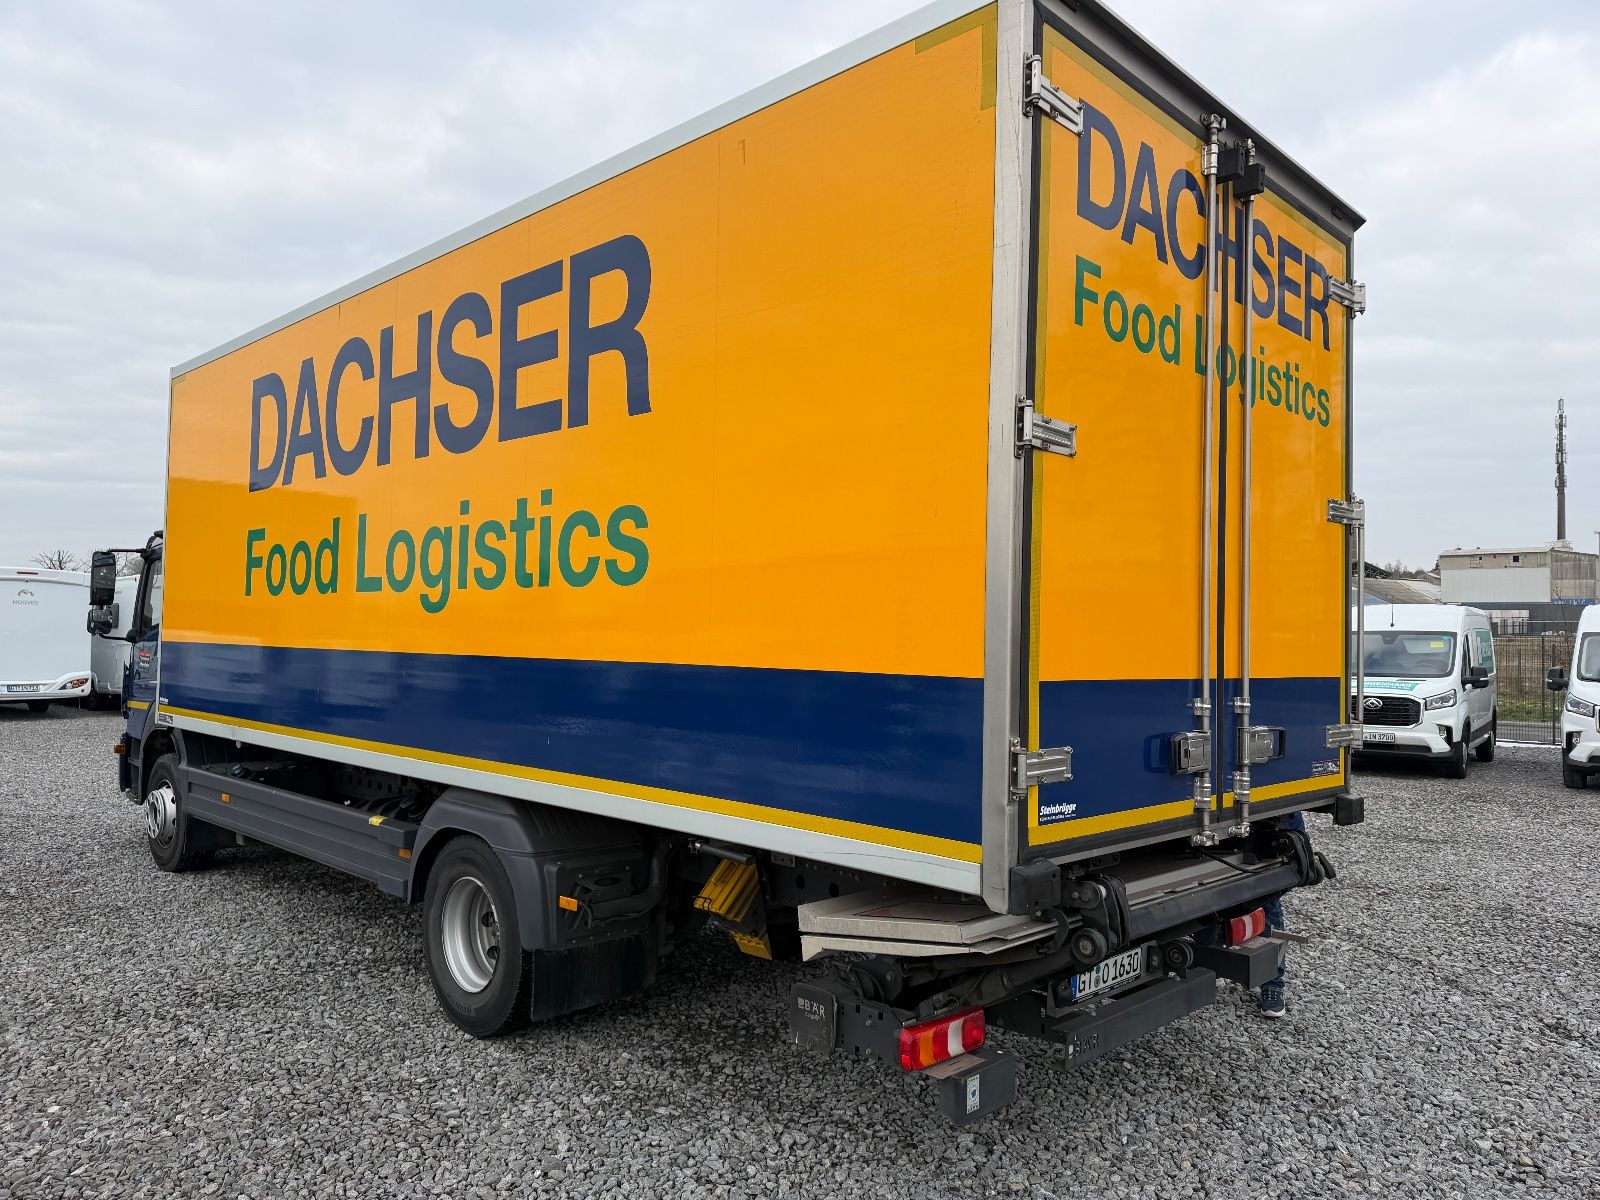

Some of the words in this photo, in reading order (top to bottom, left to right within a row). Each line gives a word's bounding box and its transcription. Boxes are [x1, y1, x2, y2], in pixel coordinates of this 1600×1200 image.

[1077, 98, 1330, 352] DACHSER
[248, 234, 653, 492] DACHSER
[1074, 254, 1181, 366] Food
[1195, 314, 1330, 428] Logistics
[245, 516, 340, 597] Food
[356, 488, 650, 614] Logistics
[1078, 969, 1093, 993] GT
[1112, 952, 1139, 981] 1630
